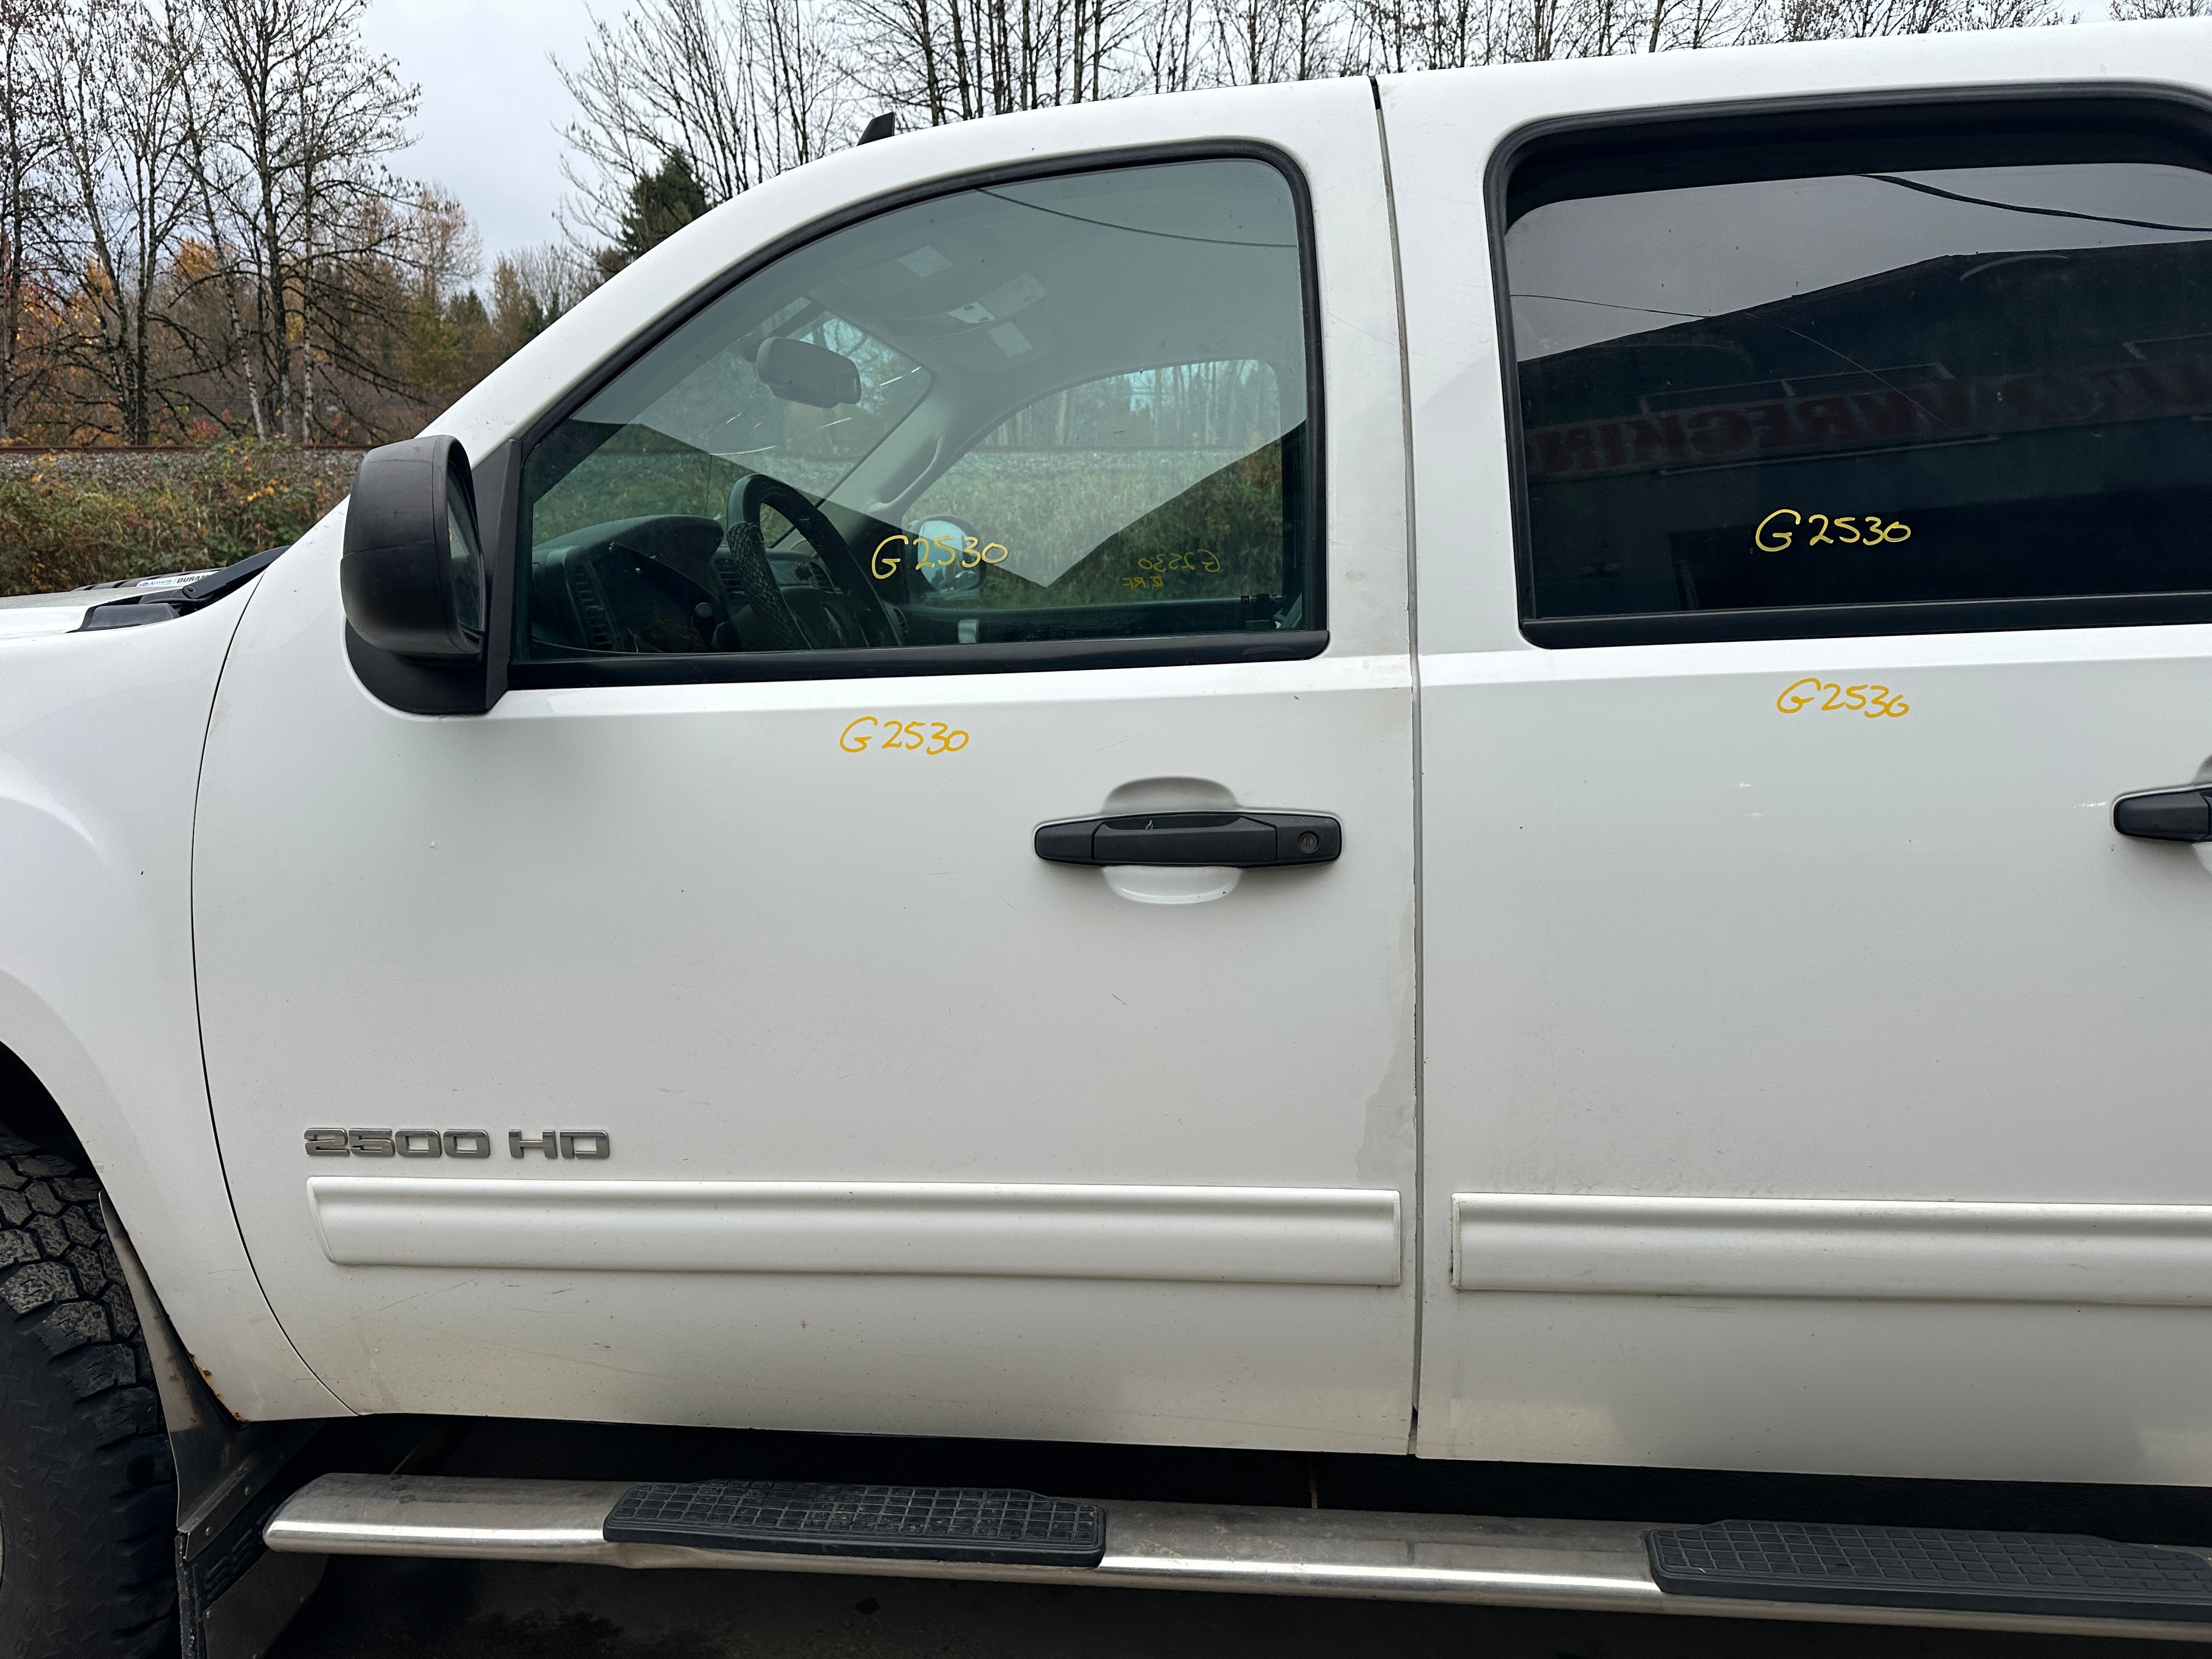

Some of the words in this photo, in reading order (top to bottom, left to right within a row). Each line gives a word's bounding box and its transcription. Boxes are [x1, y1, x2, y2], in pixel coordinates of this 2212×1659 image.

[1755, 508, 1911, 552] G2530
[871, 535, 1008, 579] G2530
[839, 715, 970, 756] G2530
[304, 1127, 491, 1158] 2500
[508, 1129, 610, 1158] HD
